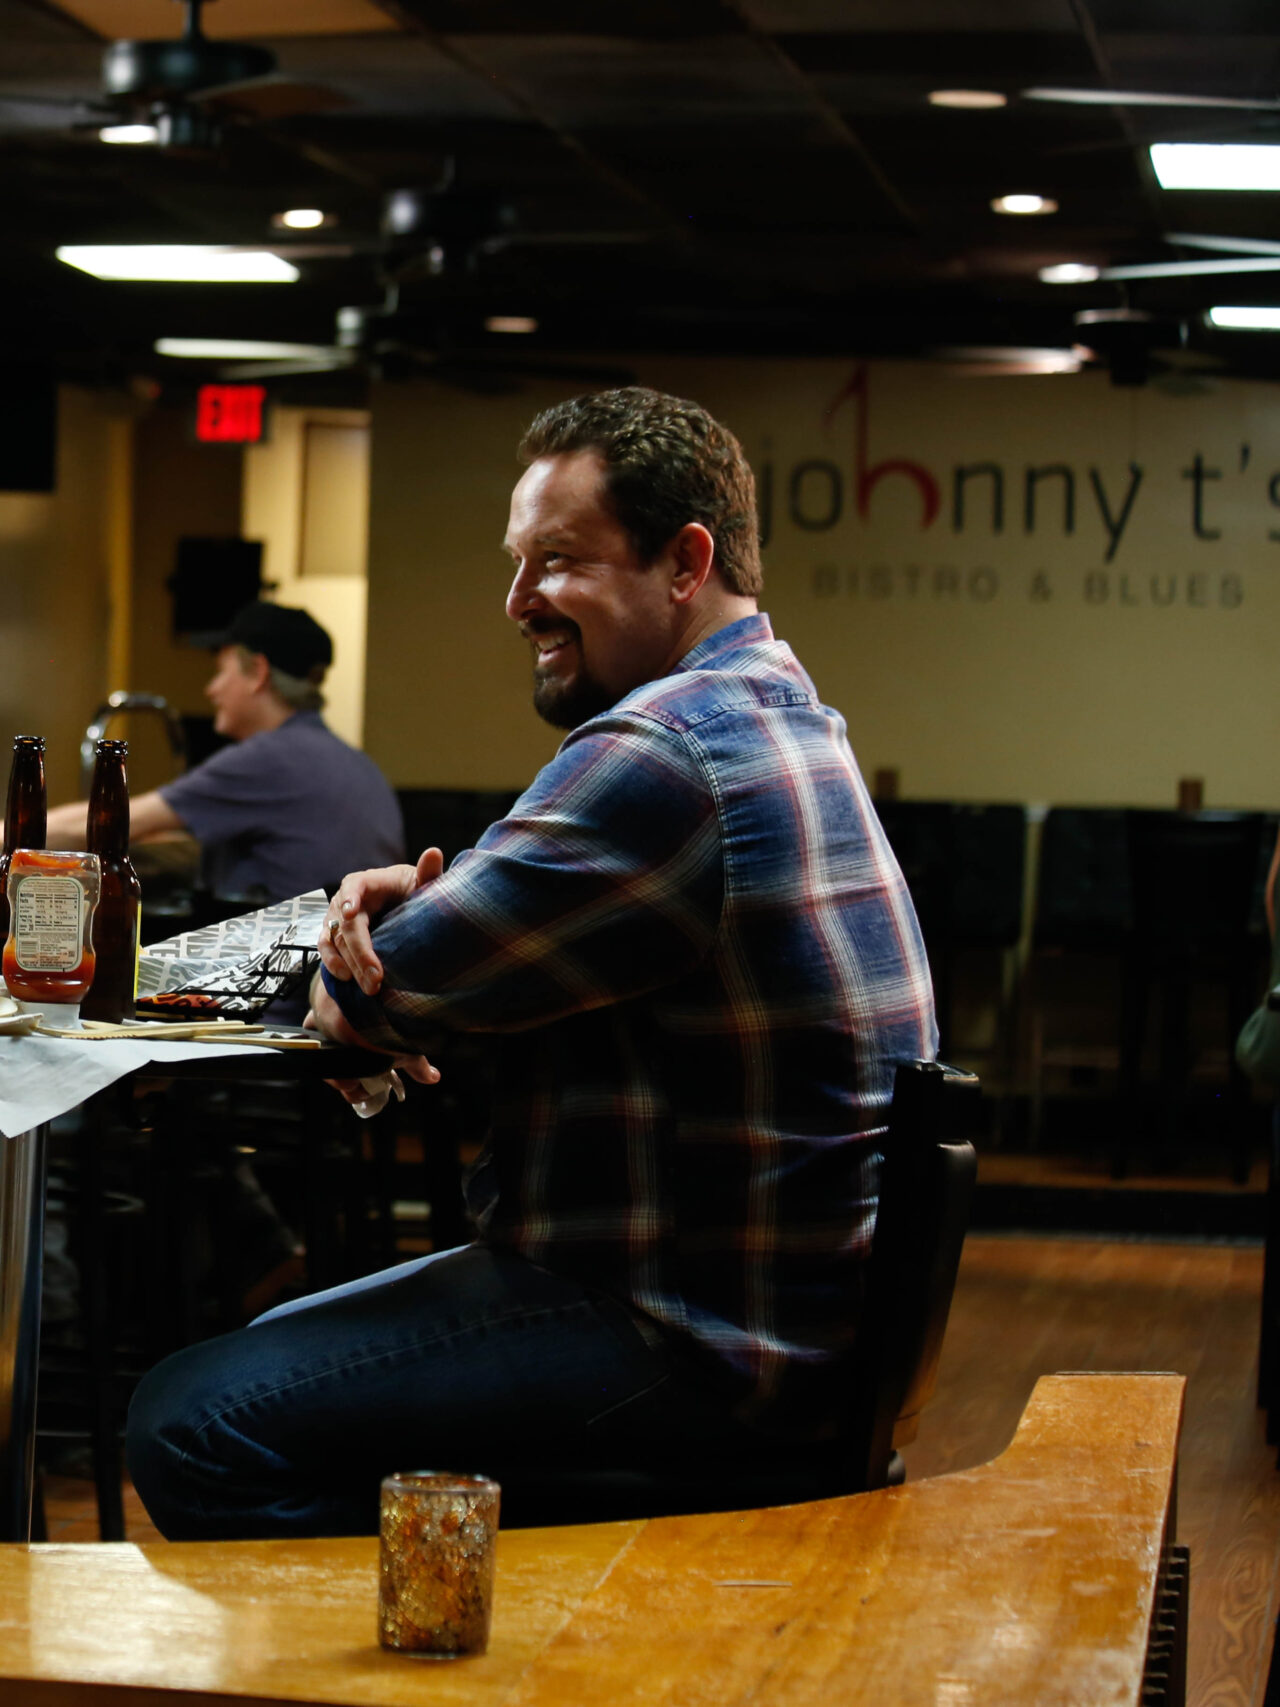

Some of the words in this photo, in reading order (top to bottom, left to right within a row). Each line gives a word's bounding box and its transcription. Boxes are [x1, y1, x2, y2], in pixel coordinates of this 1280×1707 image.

[758, 360, 1143, 564] johnny
[1180, 440, 1280, 543] t'
[814, 564, 1000, 603] BISTRO
[1085, 567, 1245, 610] BLUES
